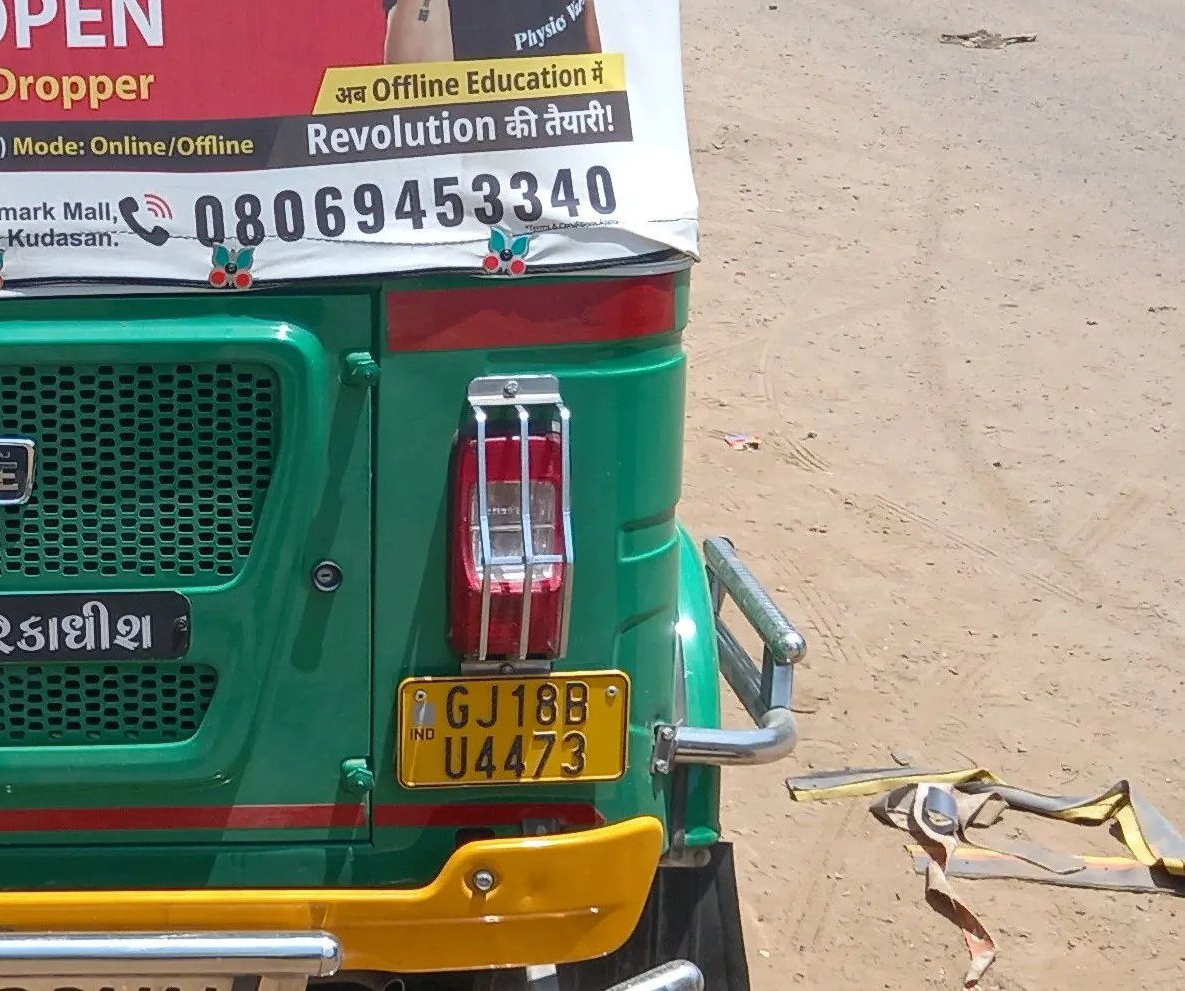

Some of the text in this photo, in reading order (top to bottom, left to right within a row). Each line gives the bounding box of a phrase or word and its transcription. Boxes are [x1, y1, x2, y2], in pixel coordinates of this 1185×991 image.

[335, 60, 604, 105] अब Offline Education में
[307, 100, 615, 156] Revolution की तैयारी!
[13, 136, 86, 158] Mode:
[90, 135, 255, 158] Online/Offline
[63, 201, 118, 224] Mall,
[194, 165, 618, 247] 08069453340
[7, 227, 119, 248] Kudasan.
[410, 728, 435, 741] IND
[444, 730, 588, 780] U4473
